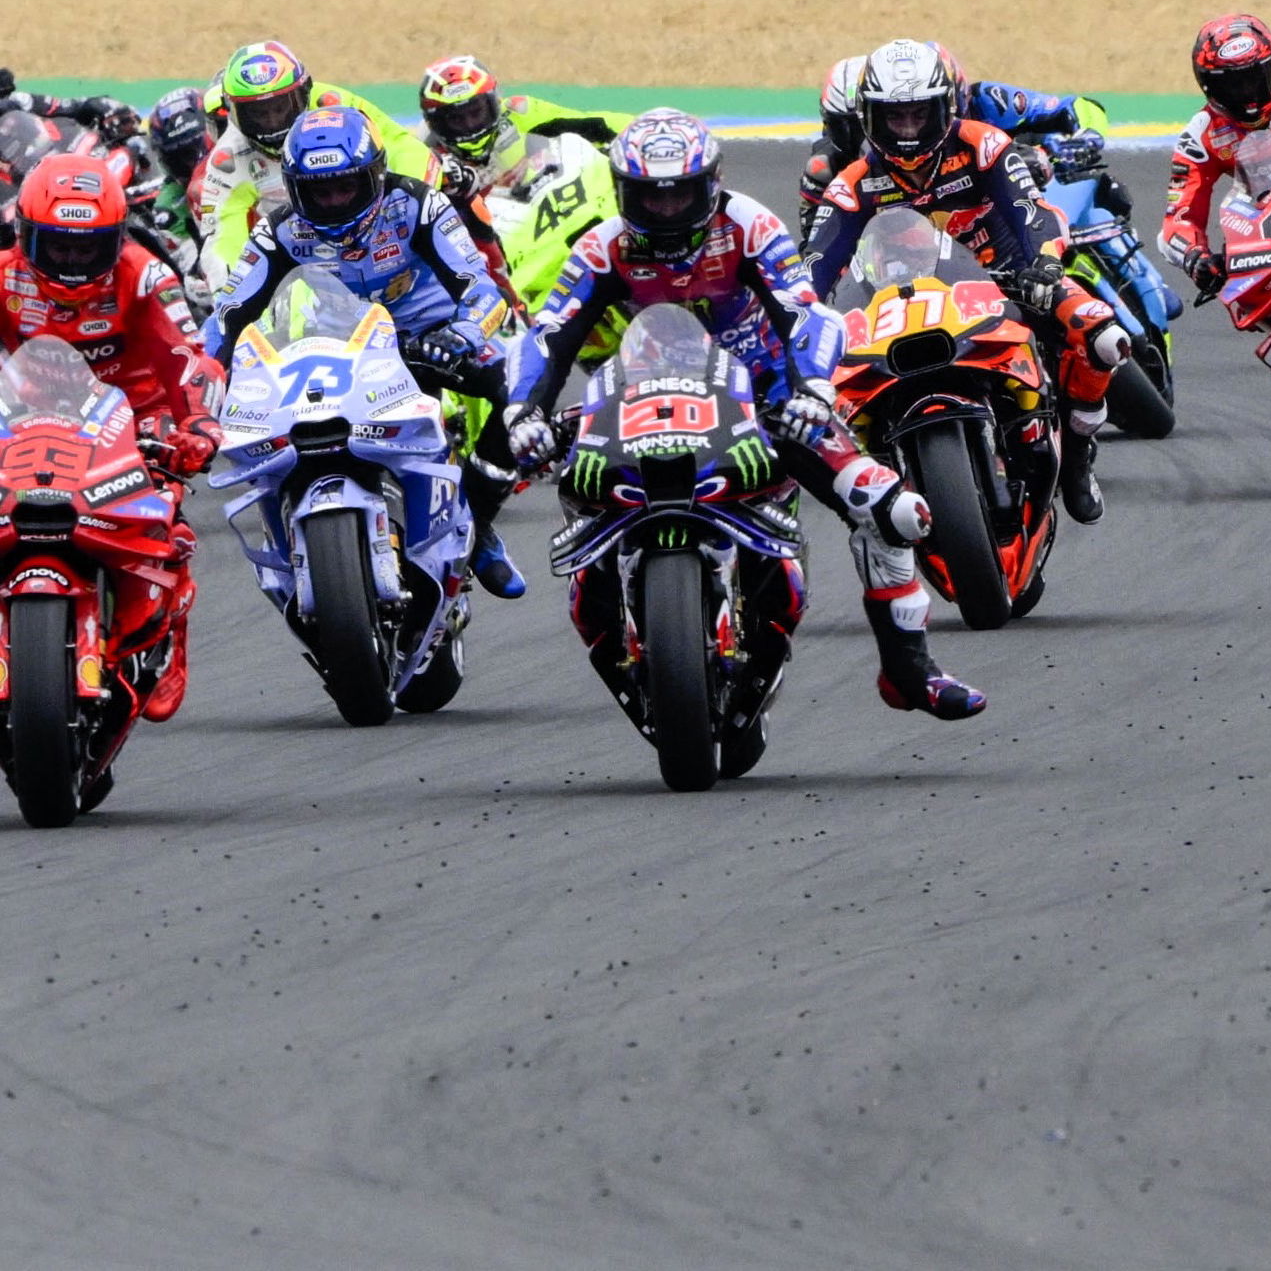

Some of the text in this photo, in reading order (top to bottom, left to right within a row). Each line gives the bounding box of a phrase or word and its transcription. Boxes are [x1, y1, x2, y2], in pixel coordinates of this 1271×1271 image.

[309, 154, 339, 166] SHOEI
[60, 209, 92, 219] SHOEI
[534, 179, 588, 242] 49
[871, 289, 950, 344] 37
[278, 354, 354, 410] 73
[366, 379, 410, 404] Unibat
[638, 376, 708, 396] ENEOS
[226, 403, 270, 422] Unibat
[619, 394, 719, 441] 20
[352, 424, 386, 436] BOLD
[622, 434, 712, 455] MONSTER
[83, 471, 145, 503] Lenovo
[762, 504, 798, 530] REEJO
[552, 517, 585, 547] REEJO
[8, 567, 69, 589] Lenovo
